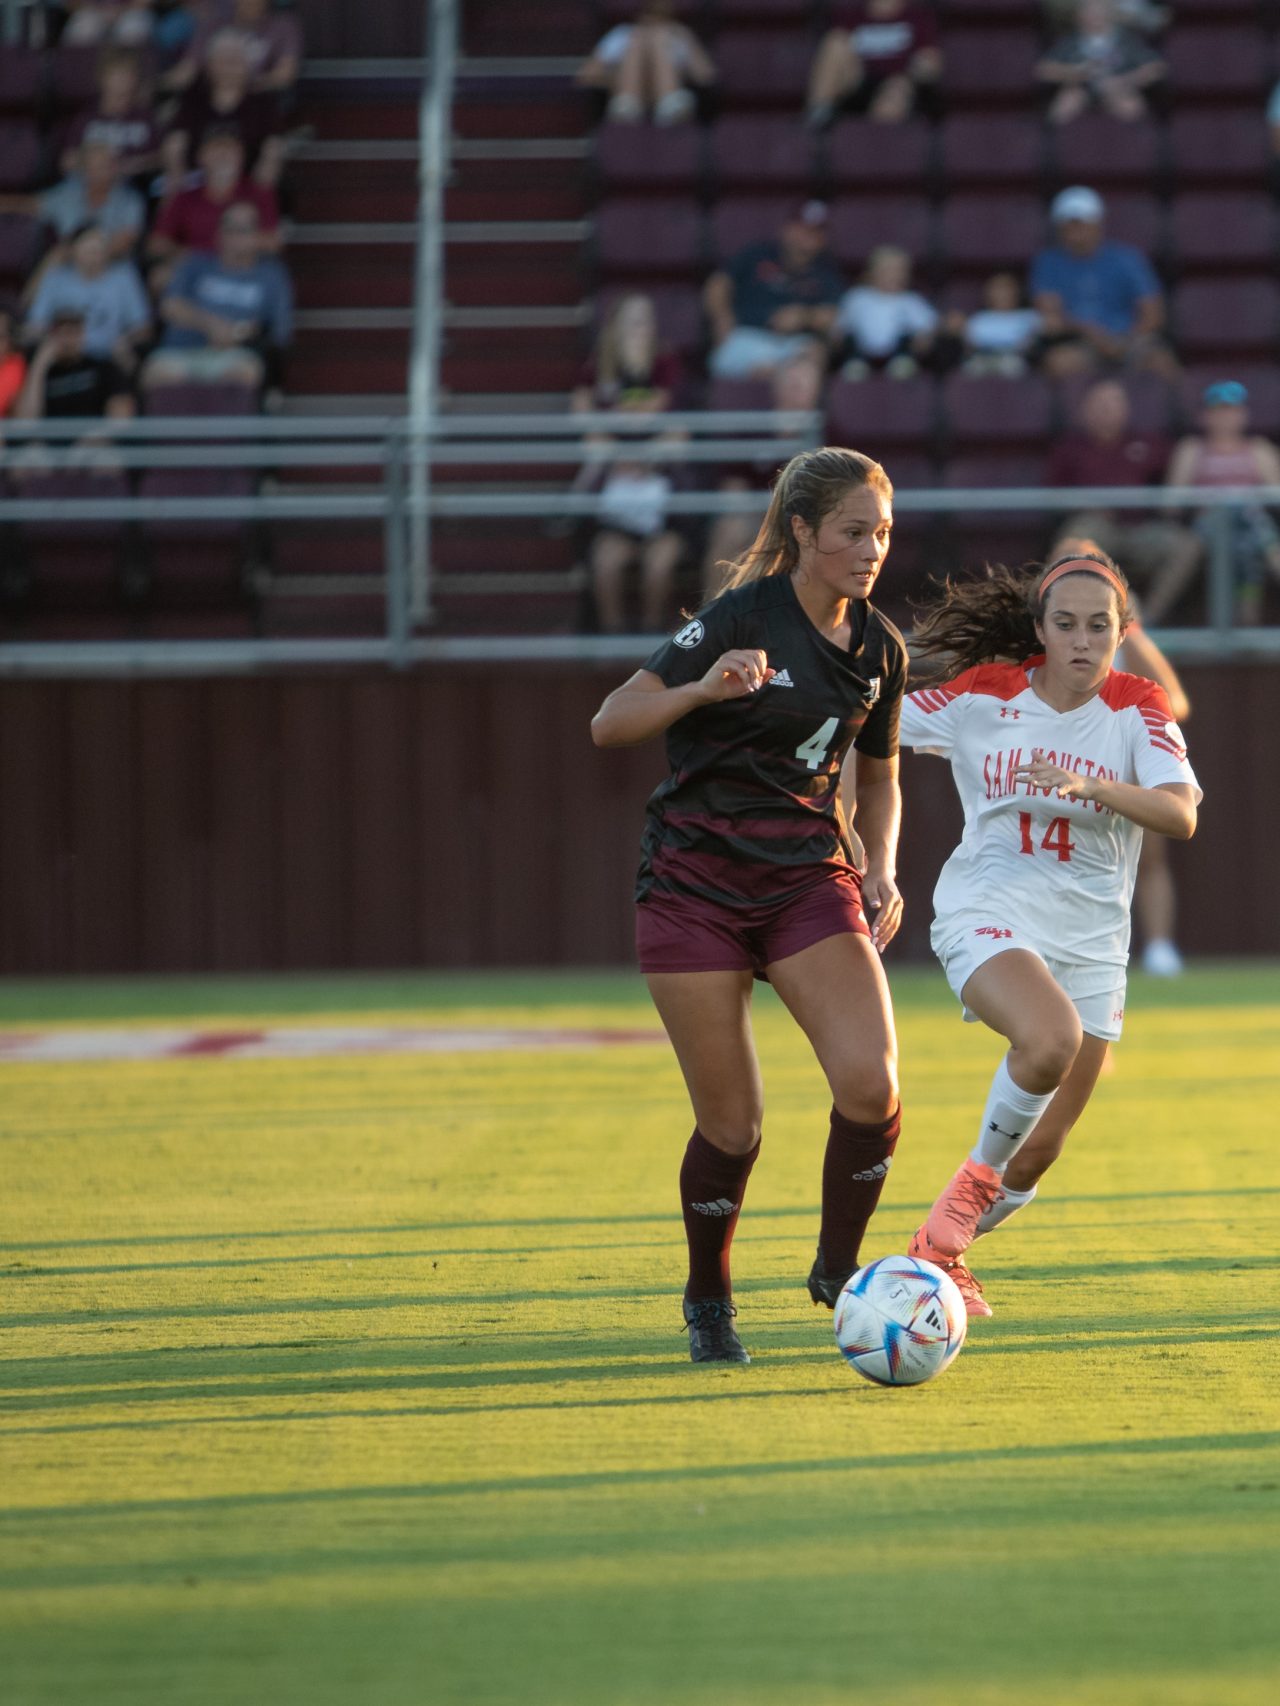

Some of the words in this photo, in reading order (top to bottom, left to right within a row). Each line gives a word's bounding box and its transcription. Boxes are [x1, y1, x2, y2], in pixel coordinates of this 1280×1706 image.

[795, 717, 840, 770] 4
[983, 747, 1023, 800] SAM
[1018, 810, 1076, 862] 14
